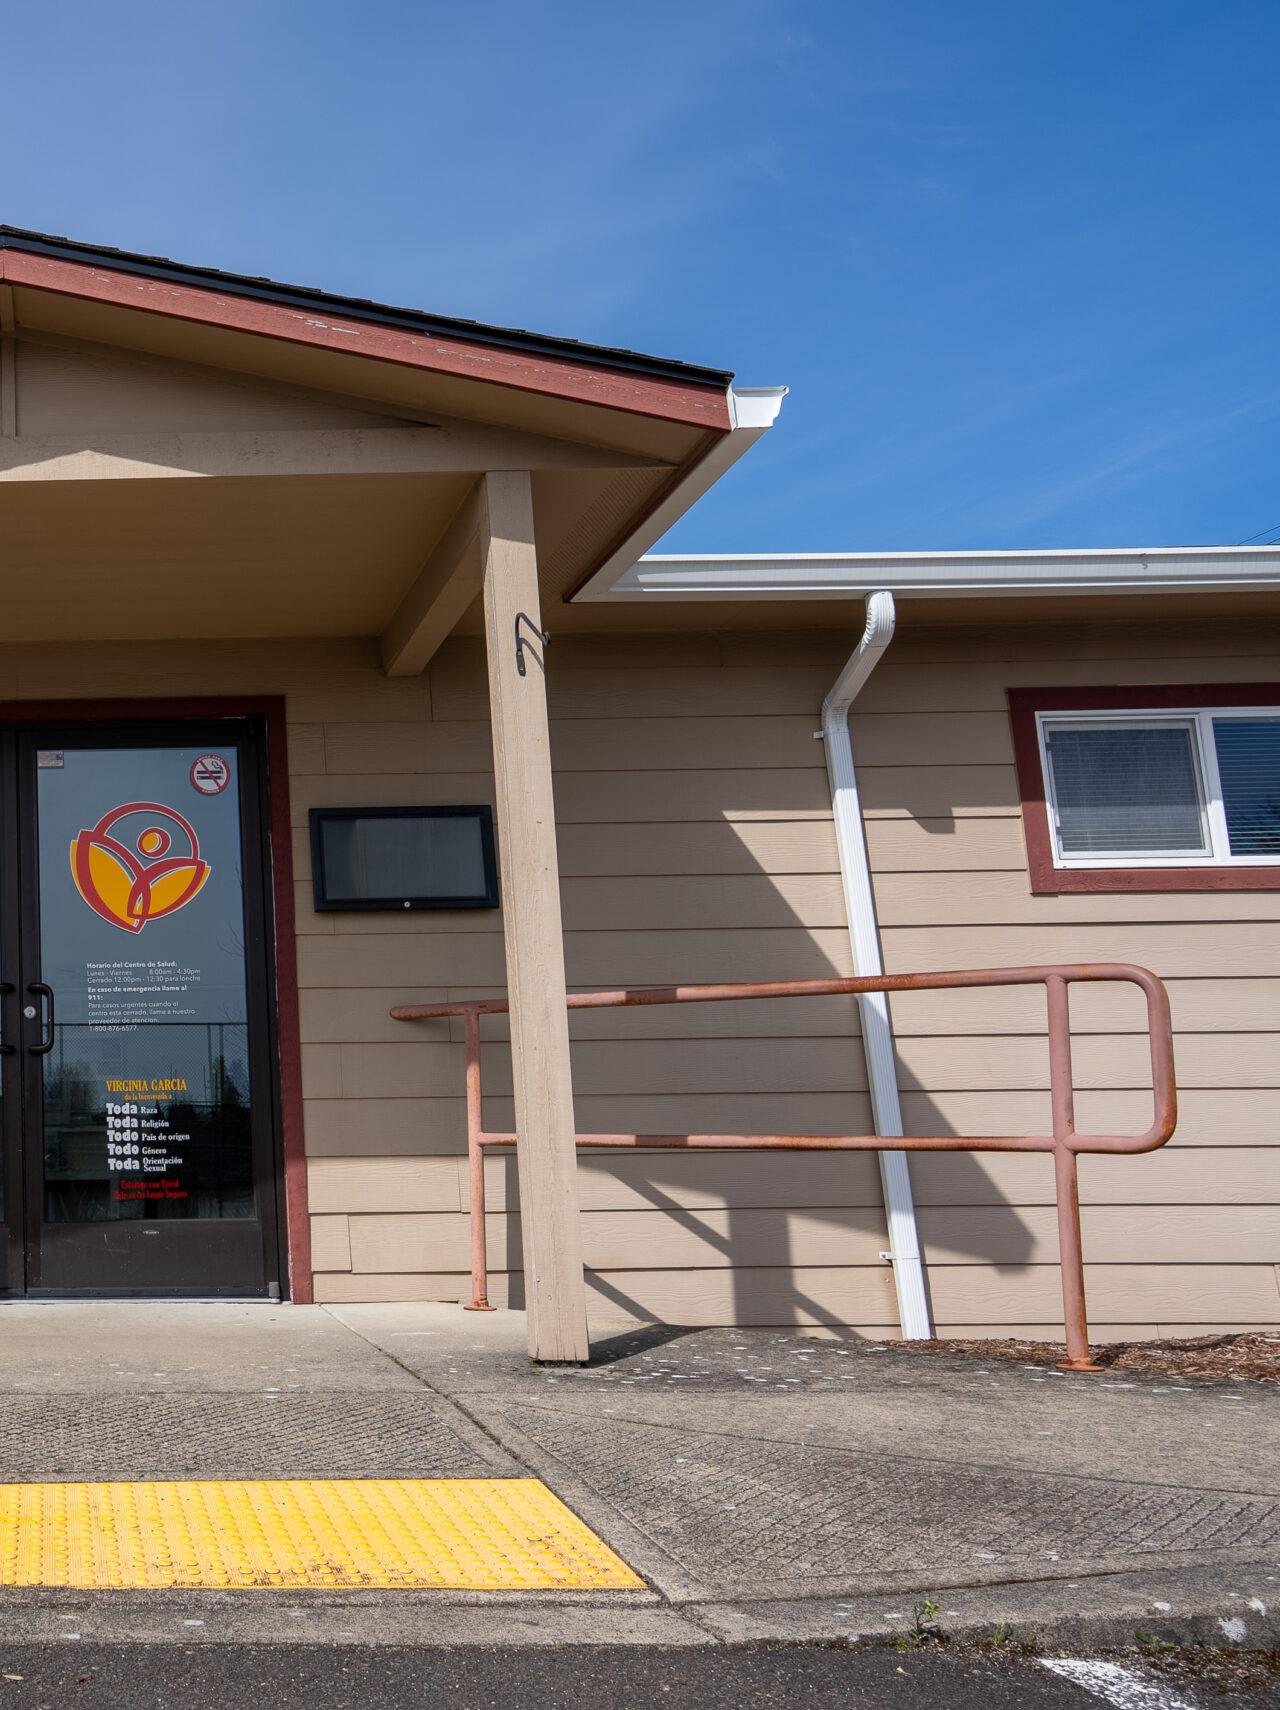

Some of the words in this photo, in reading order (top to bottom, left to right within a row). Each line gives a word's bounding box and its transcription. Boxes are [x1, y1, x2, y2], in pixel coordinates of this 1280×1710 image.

[164, 976, 179, 984] para
[87, 986, 96, 994] En
[122, 985, 161, 994] emergencia
[161, 984, 180, 992] llame
[88, 1017, 121, 1025] proveedor
[121, 1016, 131, 1024] de
[106, 1080, 149, 1092] VIRGINIA
[151, 1079, 187, 1091] GARCIA
[106, 1103, 138, 1115] Toda
[140, 1106, 158, 1114] Raza
[106, 1116, 139, 1128] Toda
[141, 1119, 169, 1129] Religión
[107, 1129, 139, 1142] Todo
[158, 1133, 167, 1141] de
[168, 1132, 190, 1142] origen
[107, 1143, 139, 1155] Todo
[142, 1146, 167, 1155] Género
[108, 1158, 140, 1170] Toda
[142, 1156, 183, 1165] Orientación
[143, 1164, 167, 1172] Sexual
